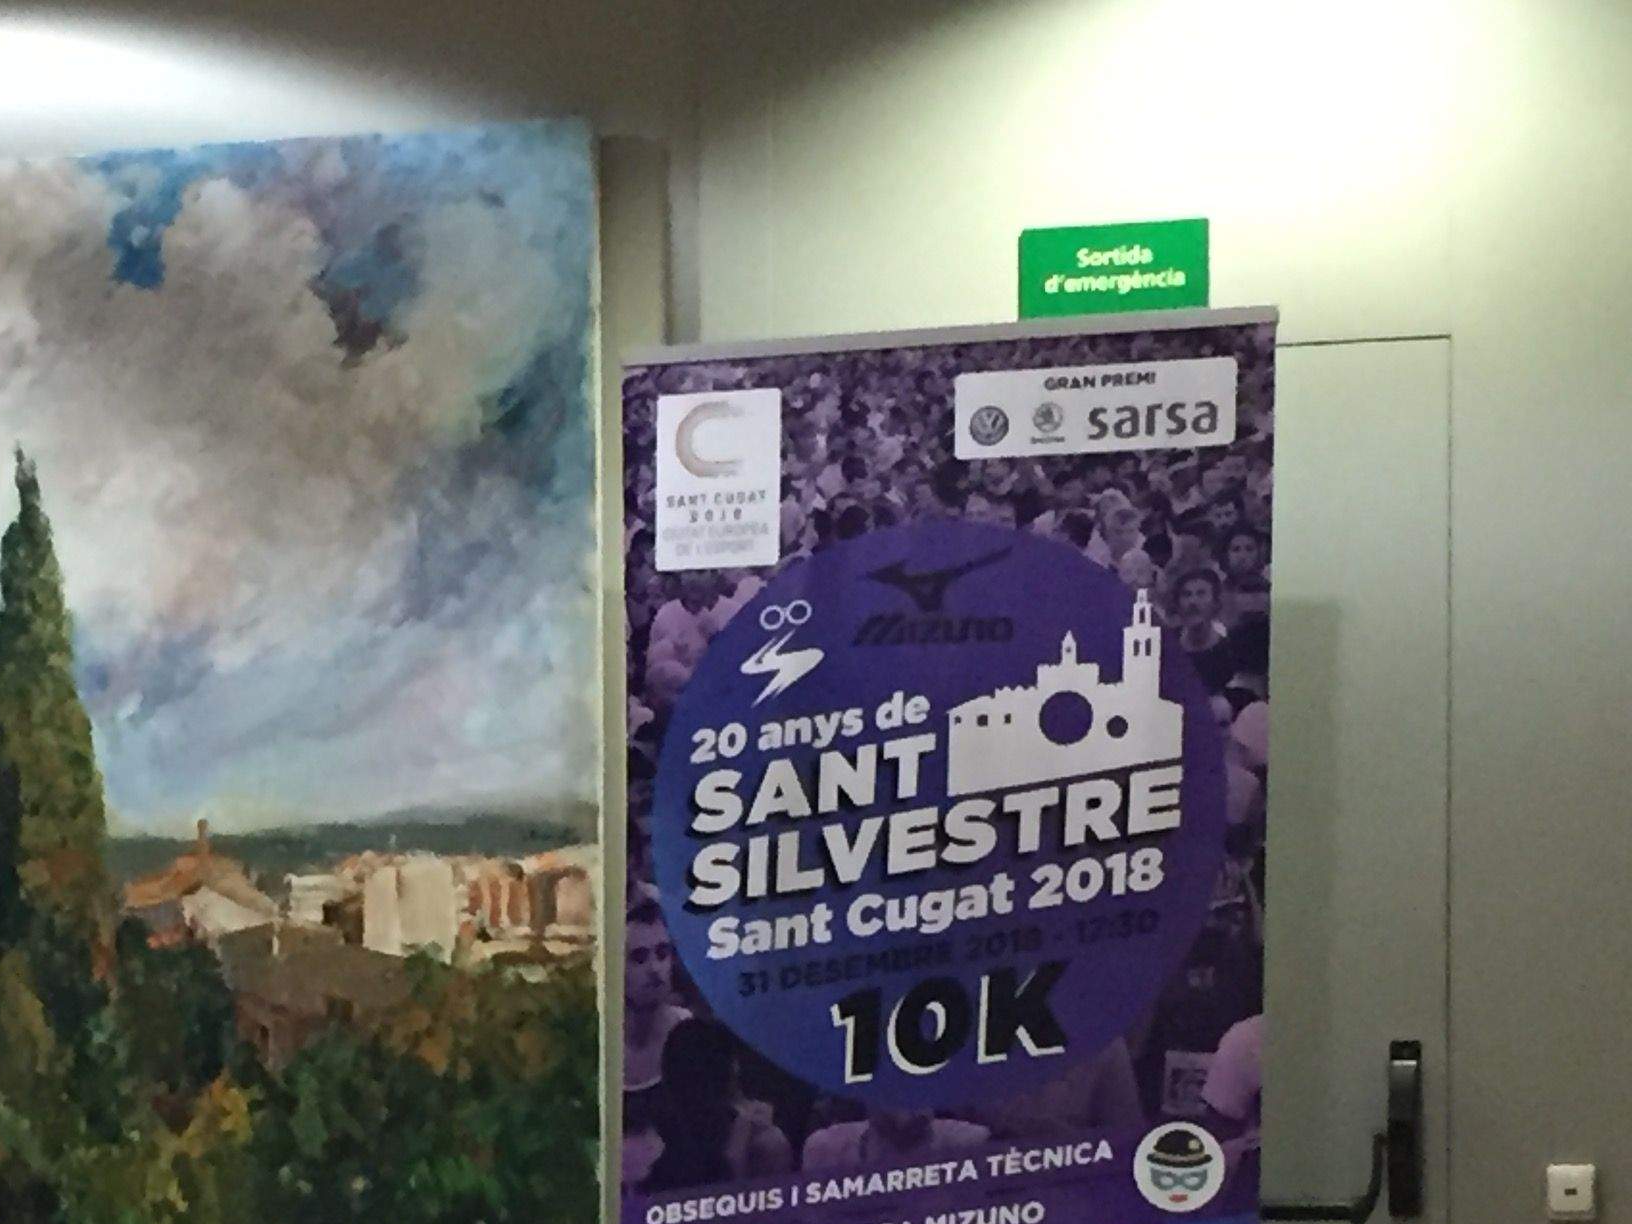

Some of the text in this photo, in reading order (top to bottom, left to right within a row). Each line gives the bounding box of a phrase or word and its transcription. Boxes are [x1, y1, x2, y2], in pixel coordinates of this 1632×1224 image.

[1076, 244, 1154, 269] Sortida
[1044, 371, 1156, 391] GRAN PREMI
[1087, 400, 1218, 441] sarsa
[689, 689, 931, 764] 20 anys de
[690, 732, 937, 834] SANT
[688, 764, 1183, 907] SILVESTRE
[705, 847, 1166, 960] Sant Cugat 2018
[779, 941, 952, 991] DESEMBRE
[829, 959, 1067, 1085] 10K
[790, 1185, 800, 1208] I
[805, 1159, 979, 1204] SAMARRETA
[986, 1139, 1114, 1177] TÈCNICA
